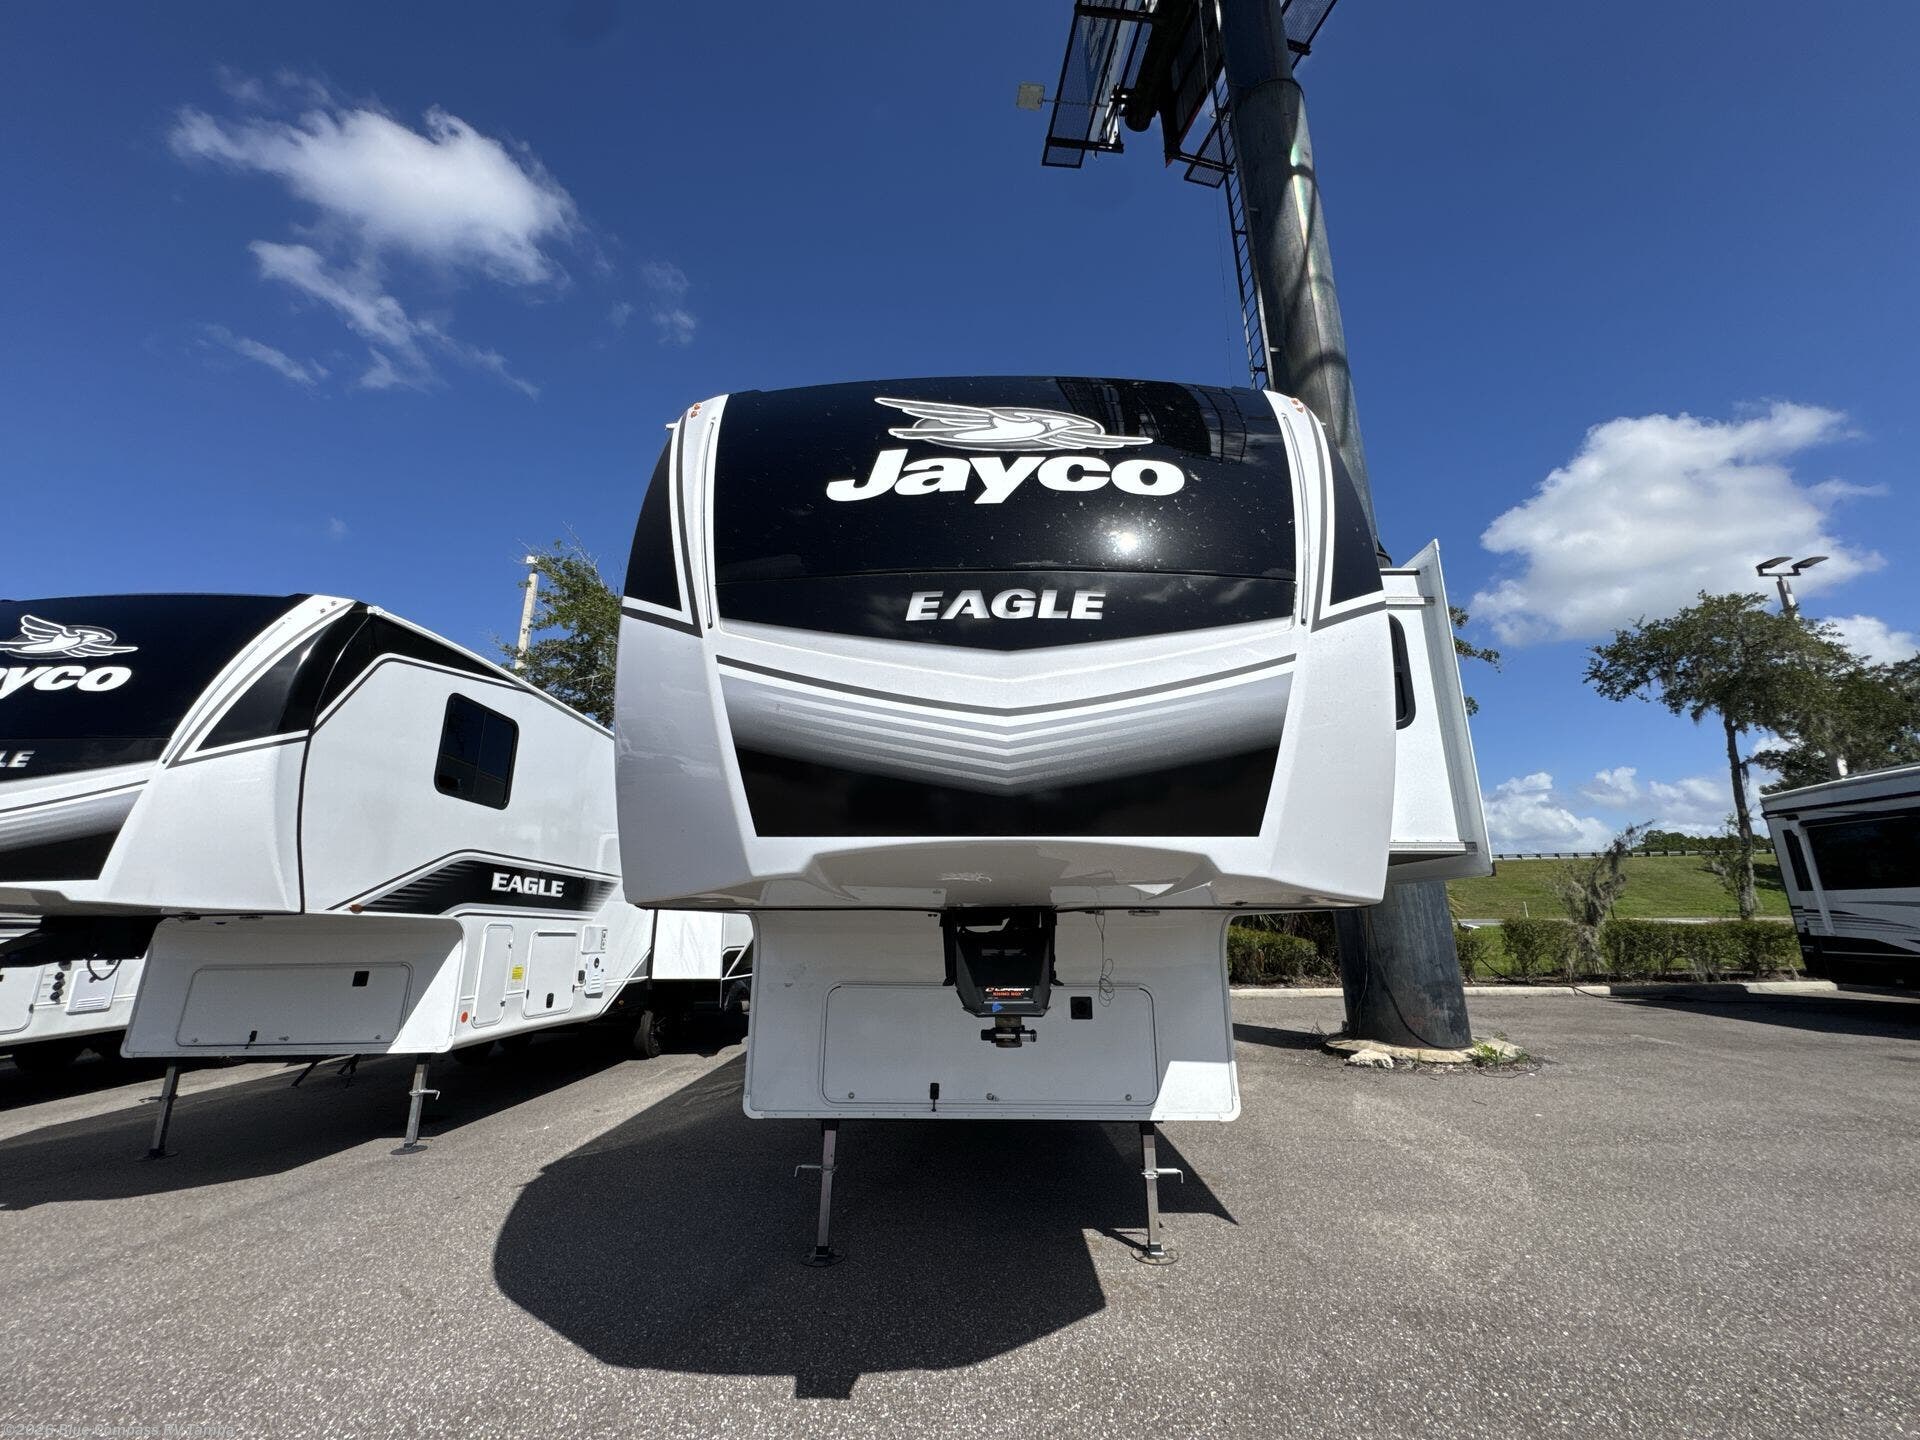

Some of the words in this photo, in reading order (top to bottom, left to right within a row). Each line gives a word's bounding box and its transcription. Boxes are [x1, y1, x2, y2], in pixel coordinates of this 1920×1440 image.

[826, 449, 1185, 505] Jayco
[905, 588, 1107, 621] EAGLE
[0, 665, 132, 700] yco
[491, 872, 565, 897] EAGLE
